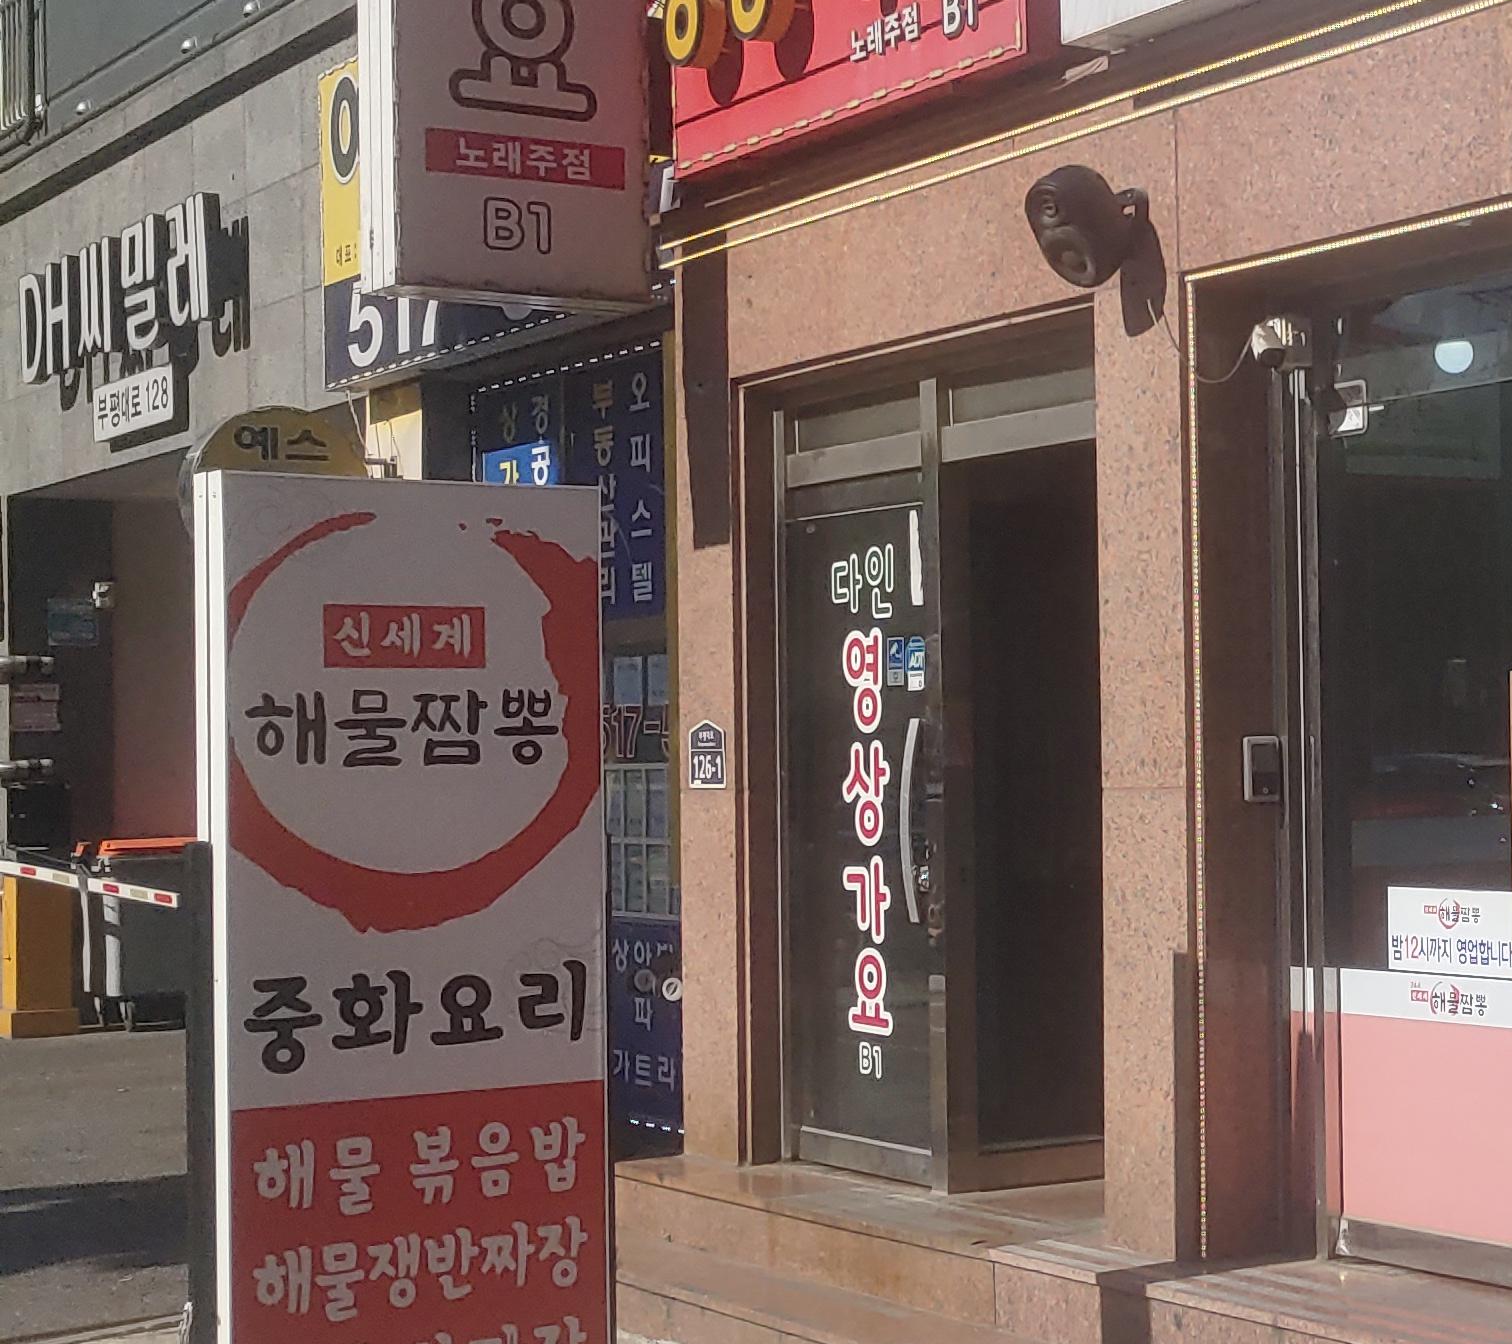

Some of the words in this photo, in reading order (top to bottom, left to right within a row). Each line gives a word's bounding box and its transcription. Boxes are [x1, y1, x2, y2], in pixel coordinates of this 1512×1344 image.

[849, 2, 921, 62] 노래주점
[455, 136, 592, 183] 노래주점
[483, 196, 553, 256] B1
[98, 384, 143, 430] 부평대로
[146, 375, 169, 414] 128
[234, 423, 328, 463] 예스
[629, 372, 653, 603] 오피스텔
[831, 543, 894, 619] 다인
[332, 612, 472, 659] 신세계
[244, 689, 562, 768] 해물짬뽕
[693, 755, 722, 779] 126-1
[841, 627, 894, 1036] 영상가요
[1391, 935, 1453, 962] 밤12시까지
[243, 960, 587, 1075] 중화요리
[1432, 991, 1487, 1016] 해물짬뽕
[858, 1041, 883, 1079] B1
[253, 1136, 381, 1216] 해물
[409, 1116, 586, 1205] 볶음밥
[253, 1215, 588, 1323] 해물쟁반짜장
